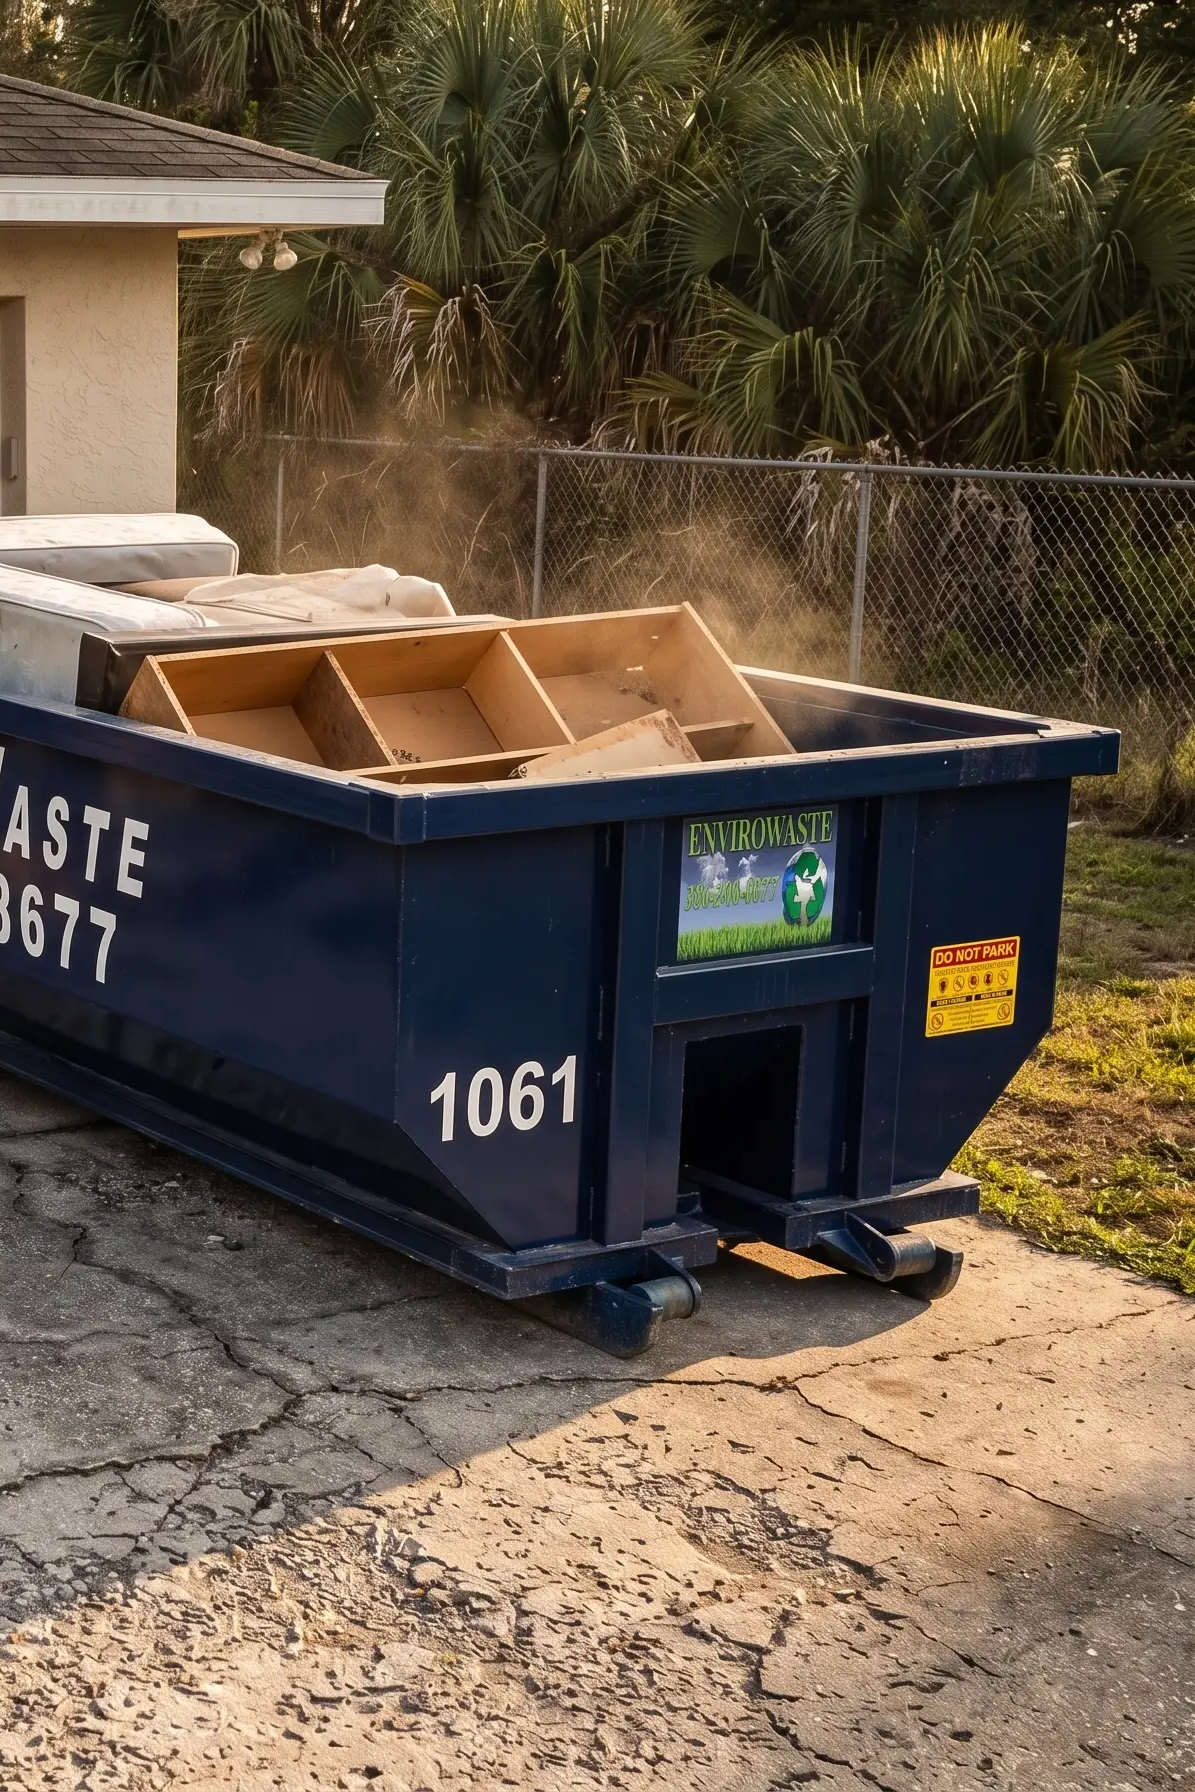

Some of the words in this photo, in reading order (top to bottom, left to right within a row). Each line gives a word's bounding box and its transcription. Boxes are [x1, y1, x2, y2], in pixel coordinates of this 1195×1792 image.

[688, 810, 833, 857] ENVIROWASTE
[935, 951, 954, 966] DO
[955, 946, 981, 962] NOT
[982, 942, 1015, 959] PARK
[430, 1054, 577, 1142] 1061
